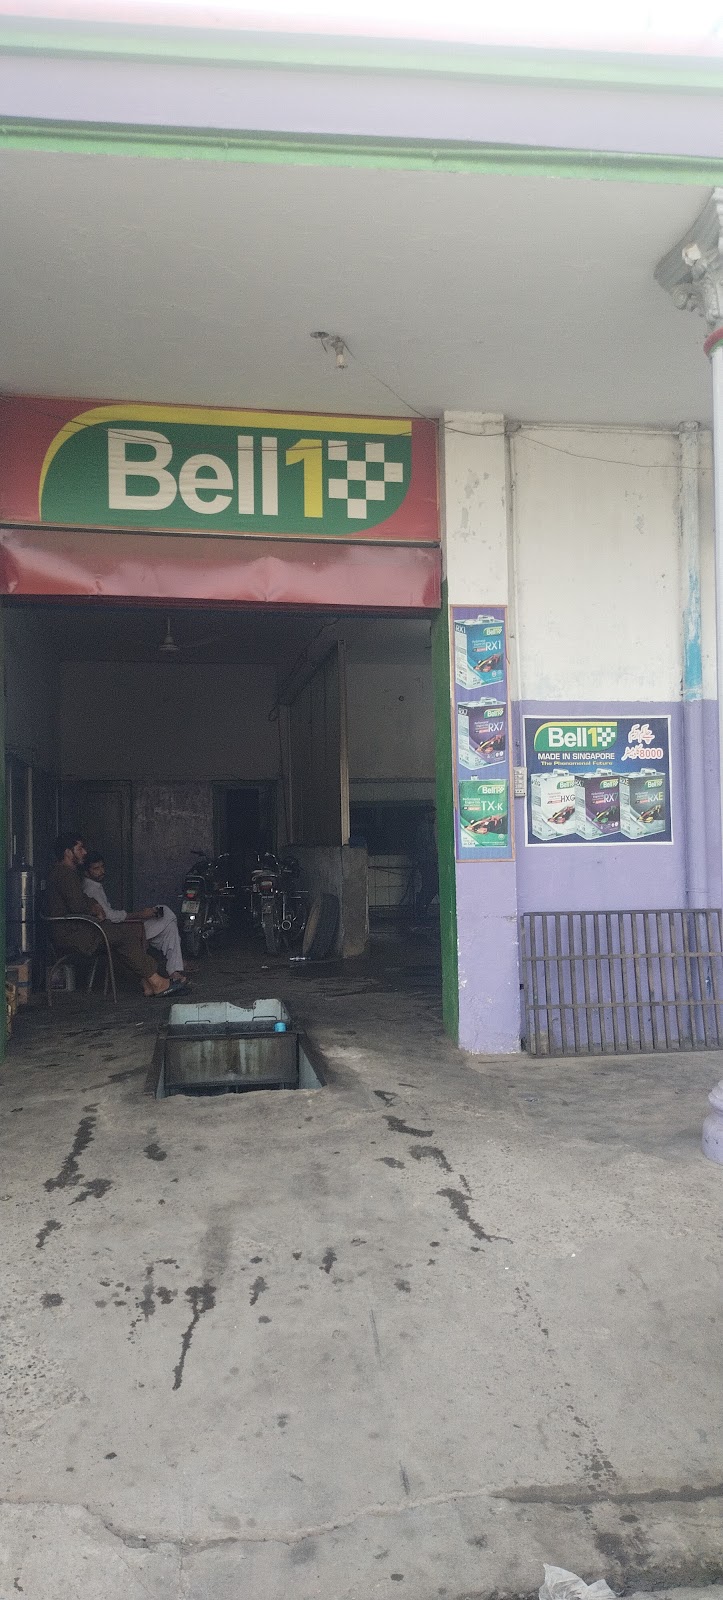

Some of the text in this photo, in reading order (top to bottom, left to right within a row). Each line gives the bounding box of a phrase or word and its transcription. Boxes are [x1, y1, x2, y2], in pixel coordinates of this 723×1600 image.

[107, 428, 323, 518] Bell1
[485, 640, 502, 651] RX1
[488, 721, 504, 732] RX7
[548, 727, 598, 747] Bell1
[537, 752, 615, 760] MADE IN SINGAPORE
[639, 748, 663, 759] 8000
[560, 794, 576, 803] HXG
[603, 793, 618, 803] RX7
[650, 792, 664, 802] RXE
